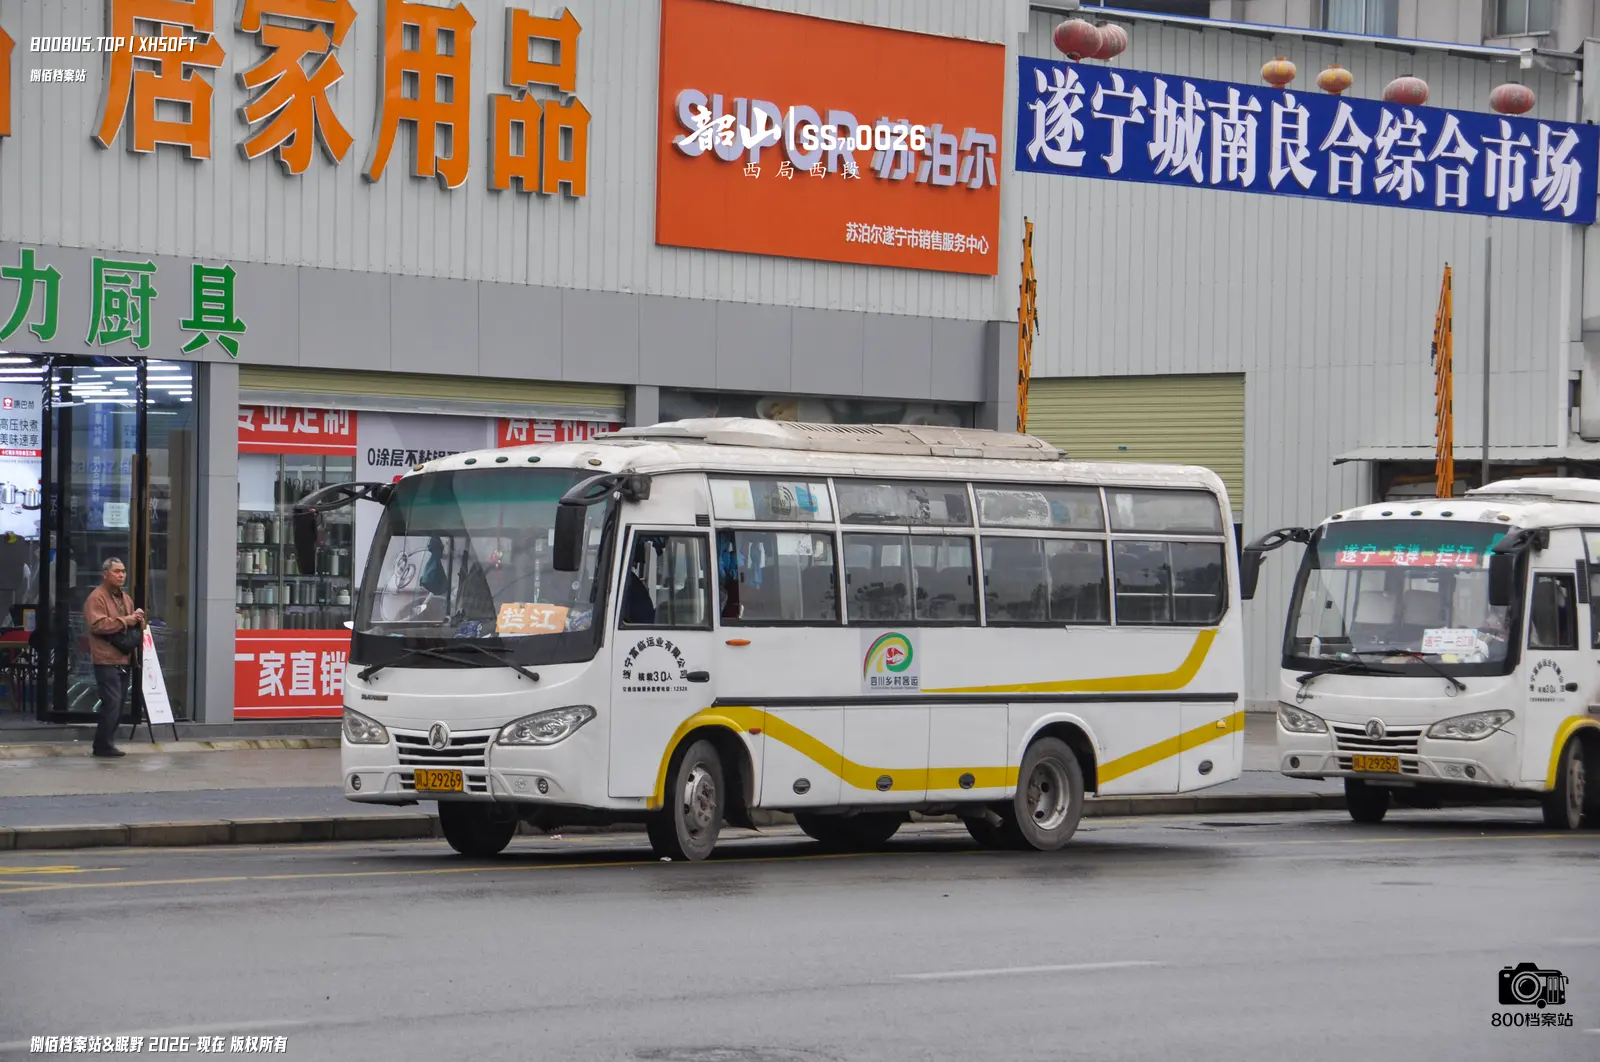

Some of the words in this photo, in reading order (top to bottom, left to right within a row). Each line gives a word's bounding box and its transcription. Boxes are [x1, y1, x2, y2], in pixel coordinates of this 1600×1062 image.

[0, 0, 592, 198] 居家用品
[1026, 65, 1582, 218] 遂宁城南良合综合市场
[0, 248, 248, 359] 力厨具
[845, 221, 990, 255] 苏泊尔遂宁市销售服务中心
